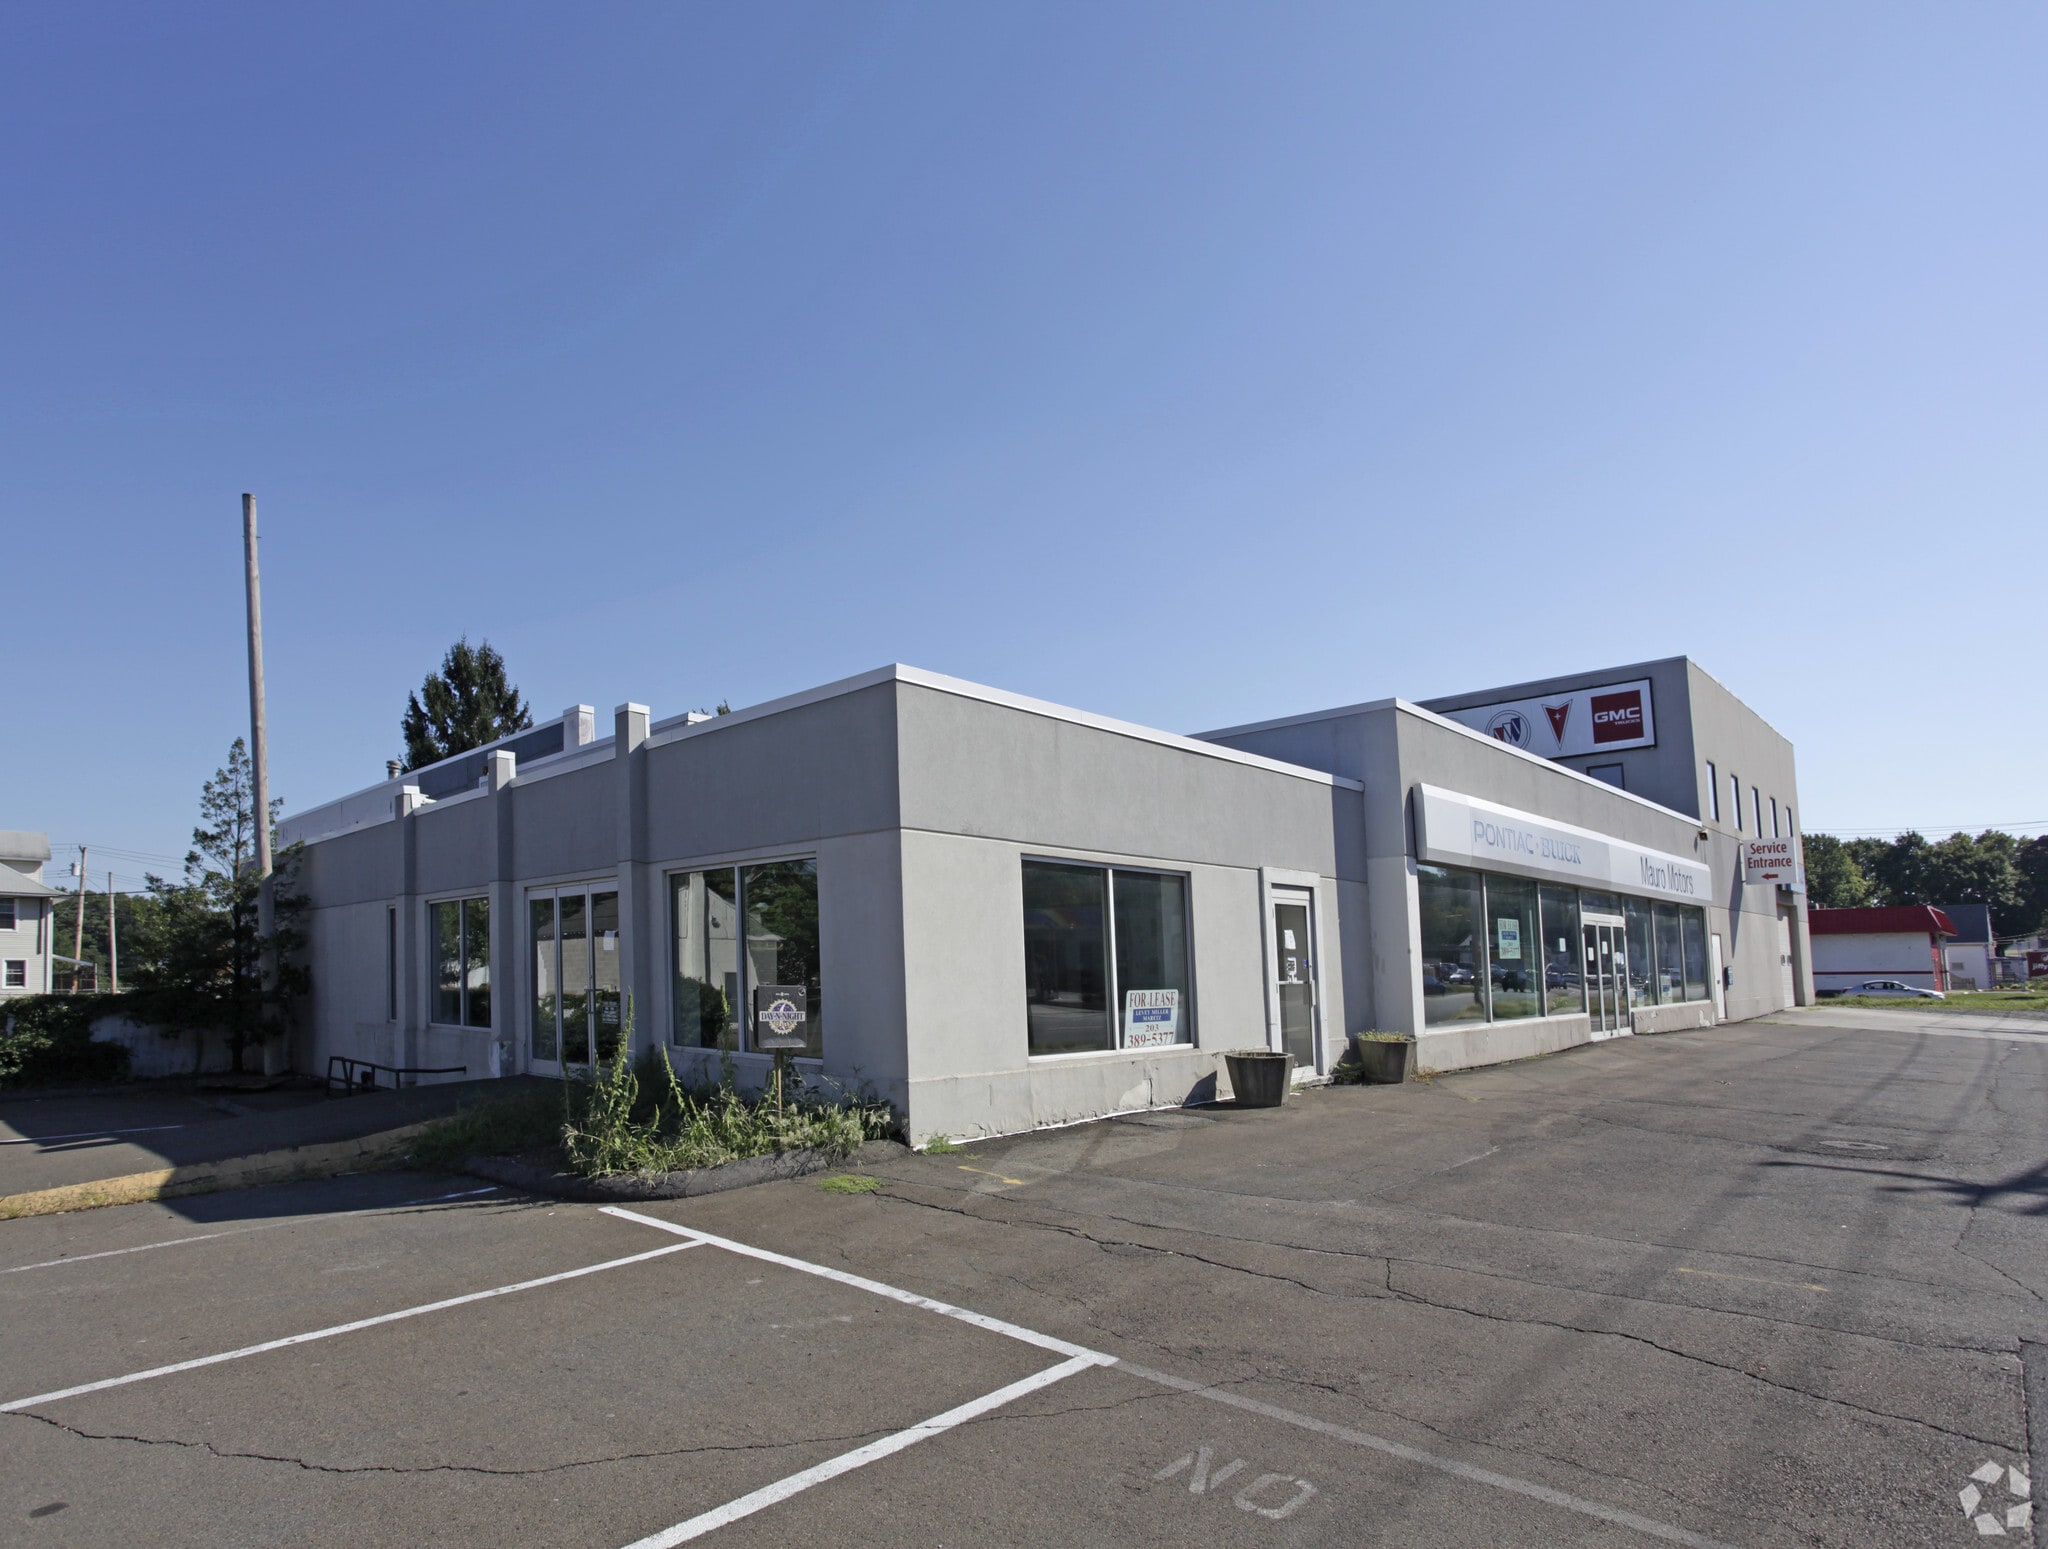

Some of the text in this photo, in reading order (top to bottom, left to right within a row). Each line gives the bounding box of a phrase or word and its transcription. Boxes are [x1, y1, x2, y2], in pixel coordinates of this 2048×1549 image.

[1594, 707, 1640, 723] GMC
[1473, 820, 1581, 864] PONTIAC BUICK
[1750, 842, 1787, 854] Service
[1747, 857, 1792, 868] Entrance
[1640, 856, 1694, 894] Mauro Motors
[1129, 991, 1176, 1007] FOR LEASE
[1145, 1024, 1159, 1032] 203
[1128, 1031, 1174, 1048] 389-5377
[1152, 1448, 1318, 1519] NO
